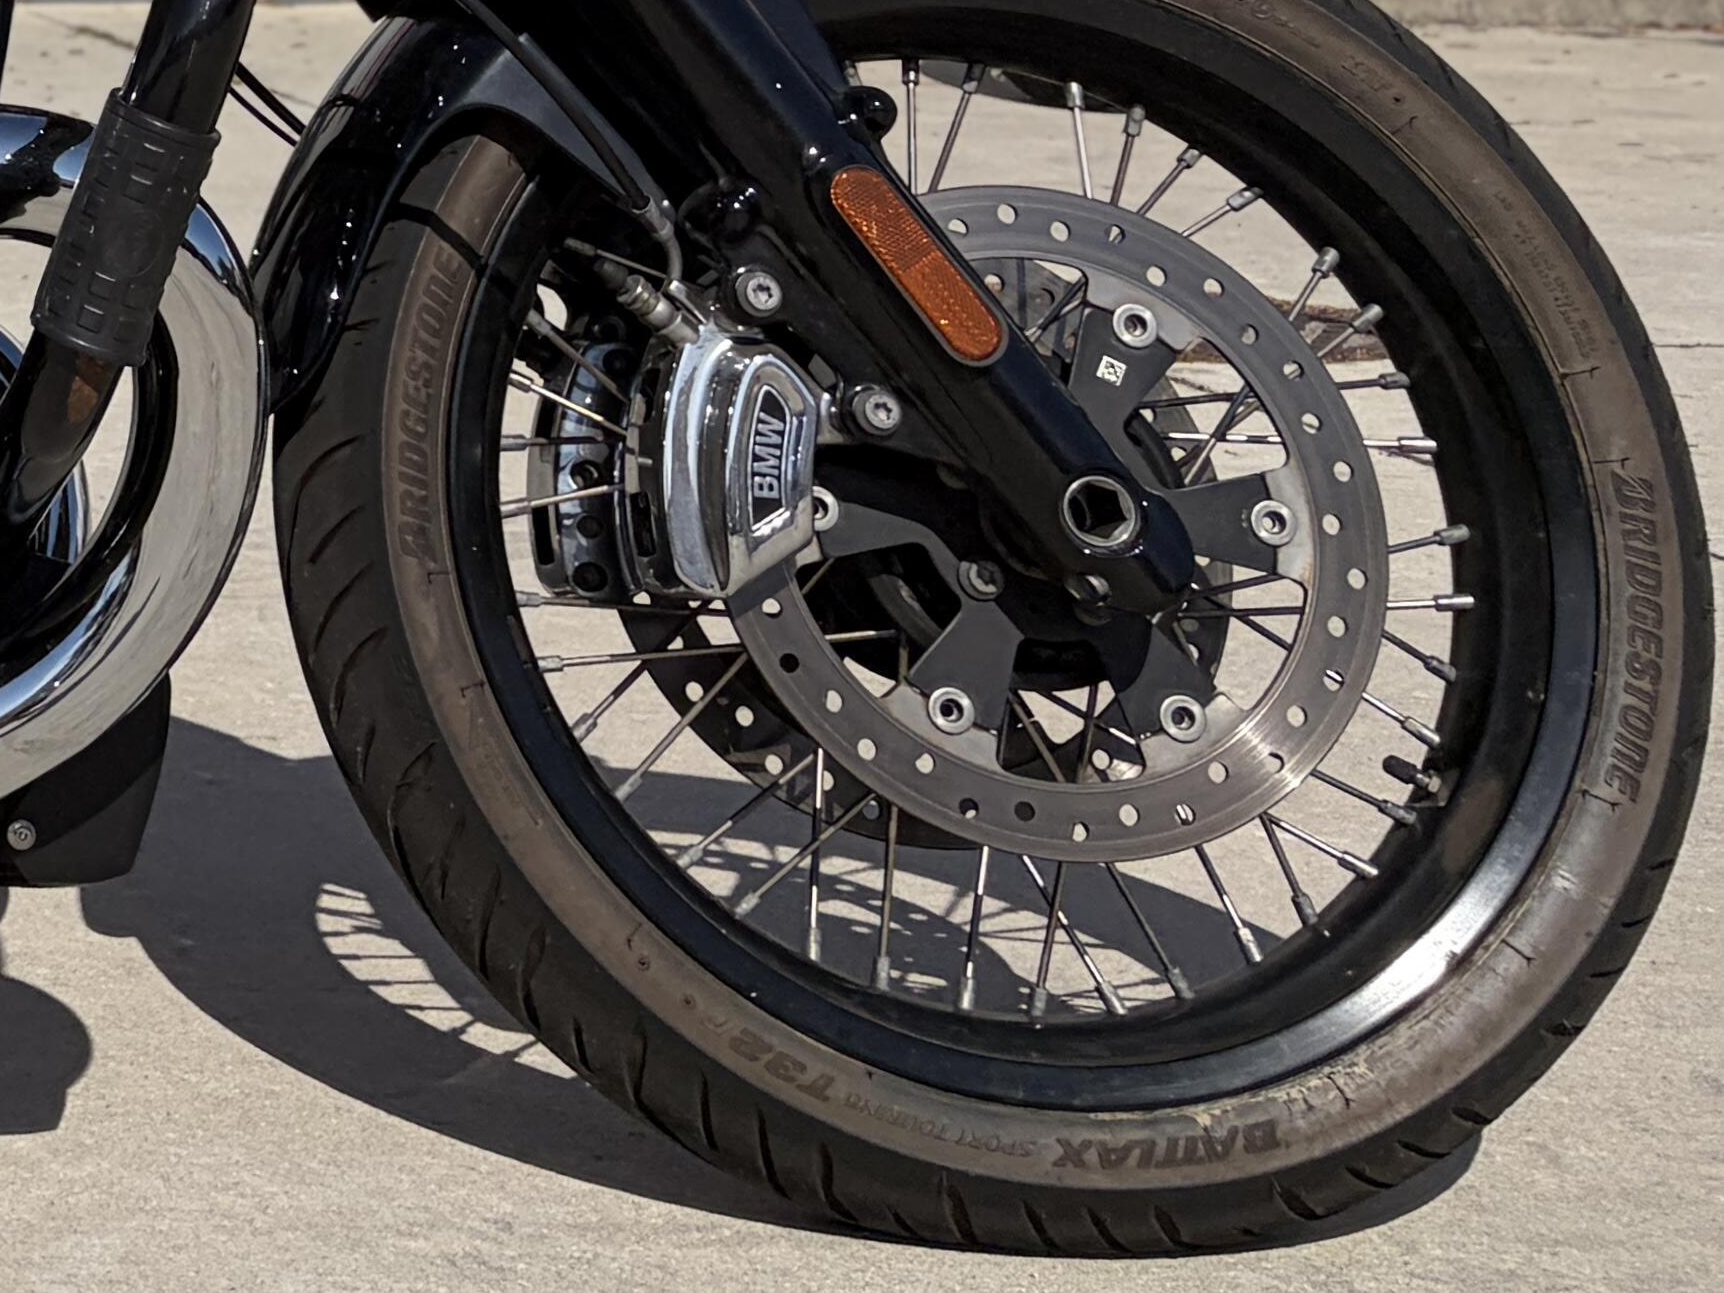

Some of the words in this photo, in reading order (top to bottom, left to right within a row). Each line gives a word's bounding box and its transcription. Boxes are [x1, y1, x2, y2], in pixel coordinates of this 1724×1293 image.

[400, 242, 467, 563] BRIDGESTONE
[752, 410, 785, 500] BMW
[1605, 470, 1664, 804] BRIDGESTONE
[728, 1032, 838, 1103] T32
[1055, 1118, 1282, 1170] BATTLAX
